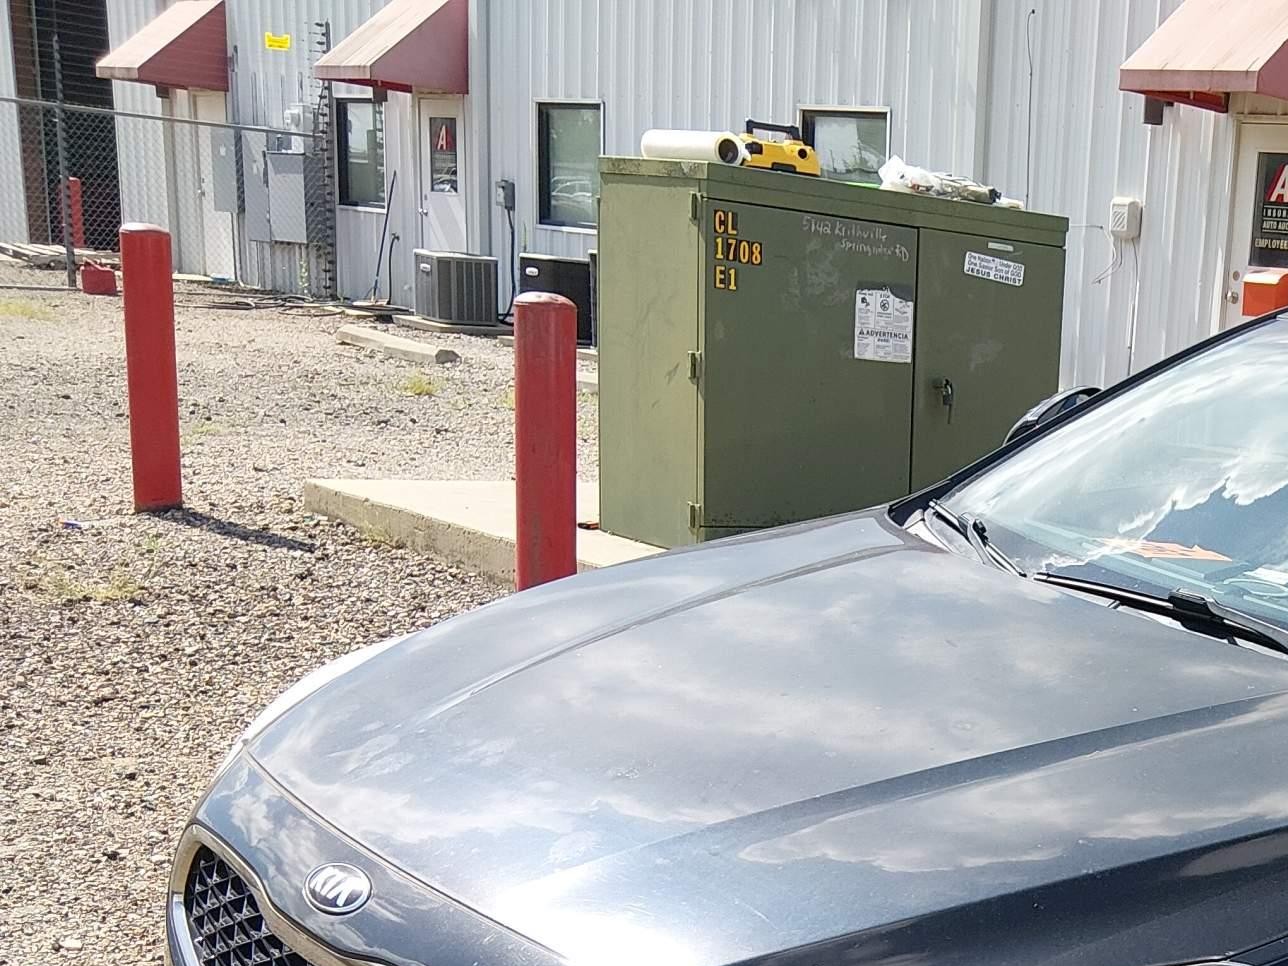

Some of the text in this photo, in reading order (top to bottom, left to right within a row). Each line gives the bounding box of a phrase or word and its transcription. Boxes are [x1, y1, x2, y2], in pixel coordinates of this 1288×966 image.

[715, 210, 737, 235] CL
[1262, 220, 1278, 230] AUTO
[715, 237, 762, 265] 1708
[715, 265, 737, 290] E1
[965, 266, 1022, 285] JESUS CHRIST
[865, 329, 909, 341] ADVERTENCIA
